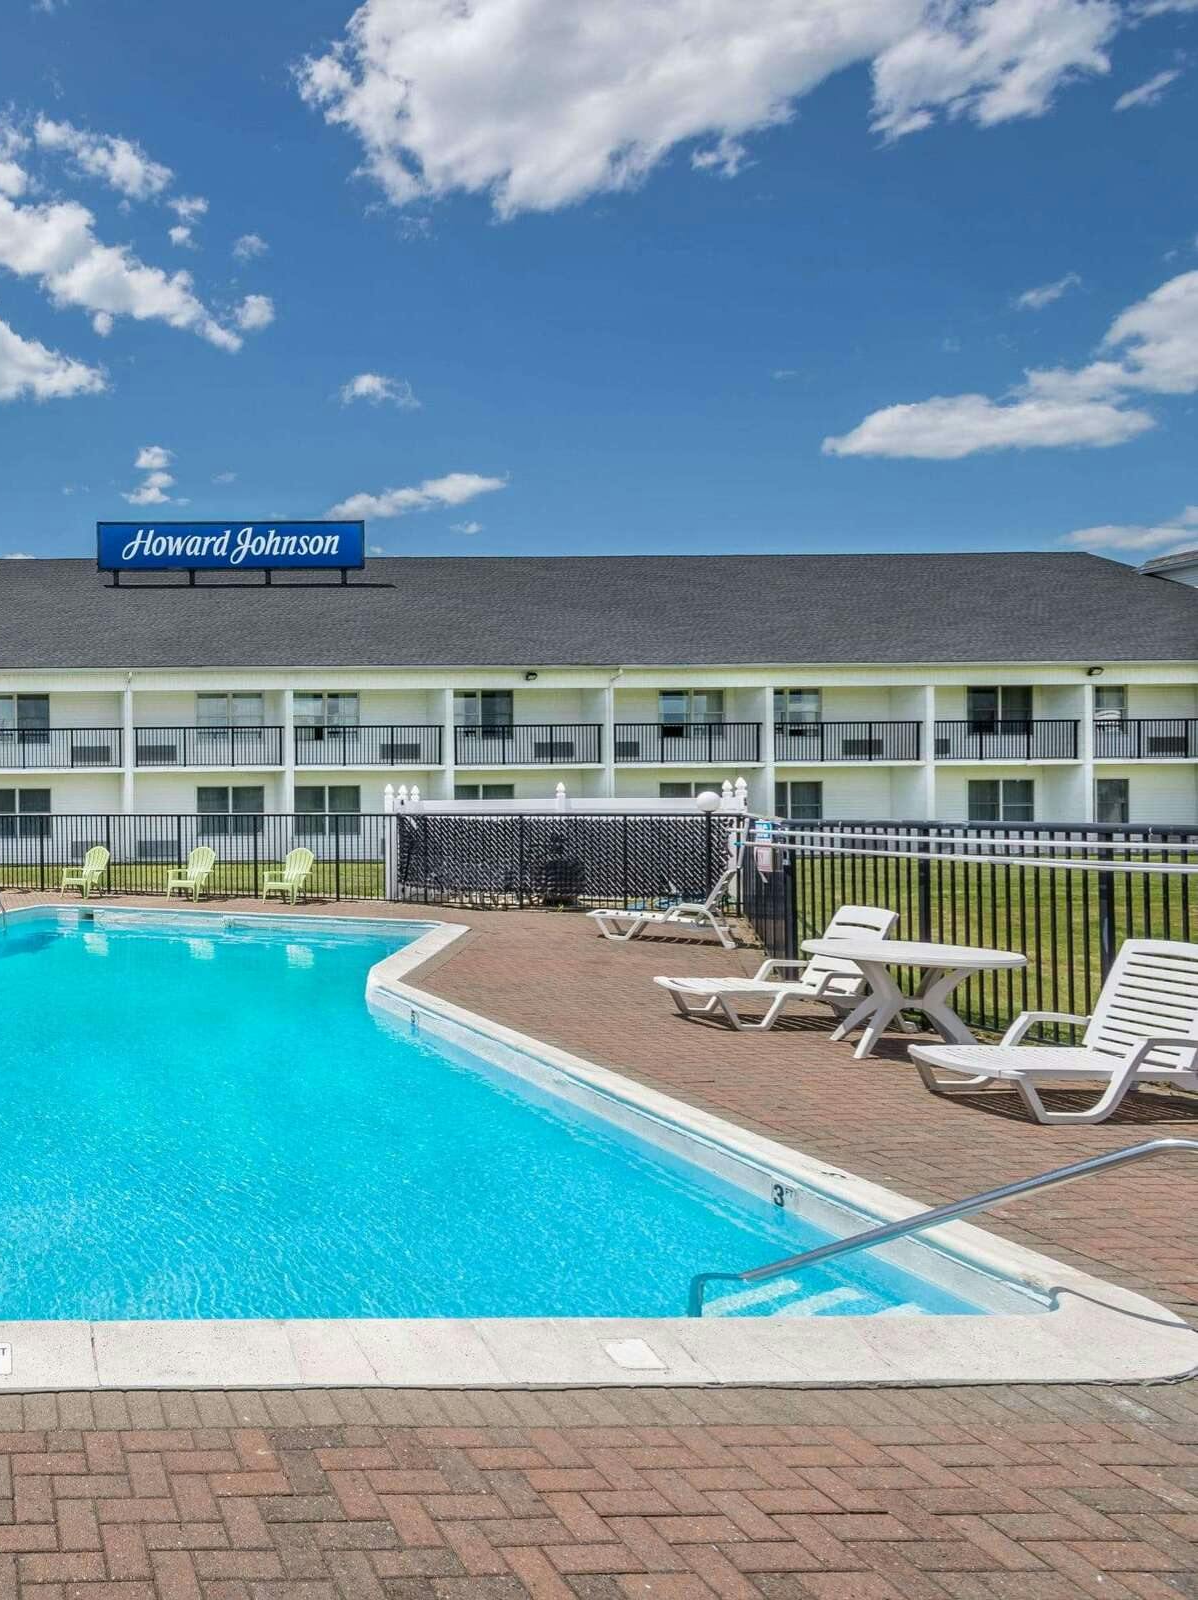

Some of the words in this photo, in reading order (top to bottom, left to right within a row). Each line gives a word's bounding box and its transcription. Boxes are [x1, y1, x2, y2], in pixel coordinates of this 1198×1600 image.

[122, 529, 230, 560] Howard
[230, 526, 340, 564] Johnson
[773, 1184, 784, 1208] 3
